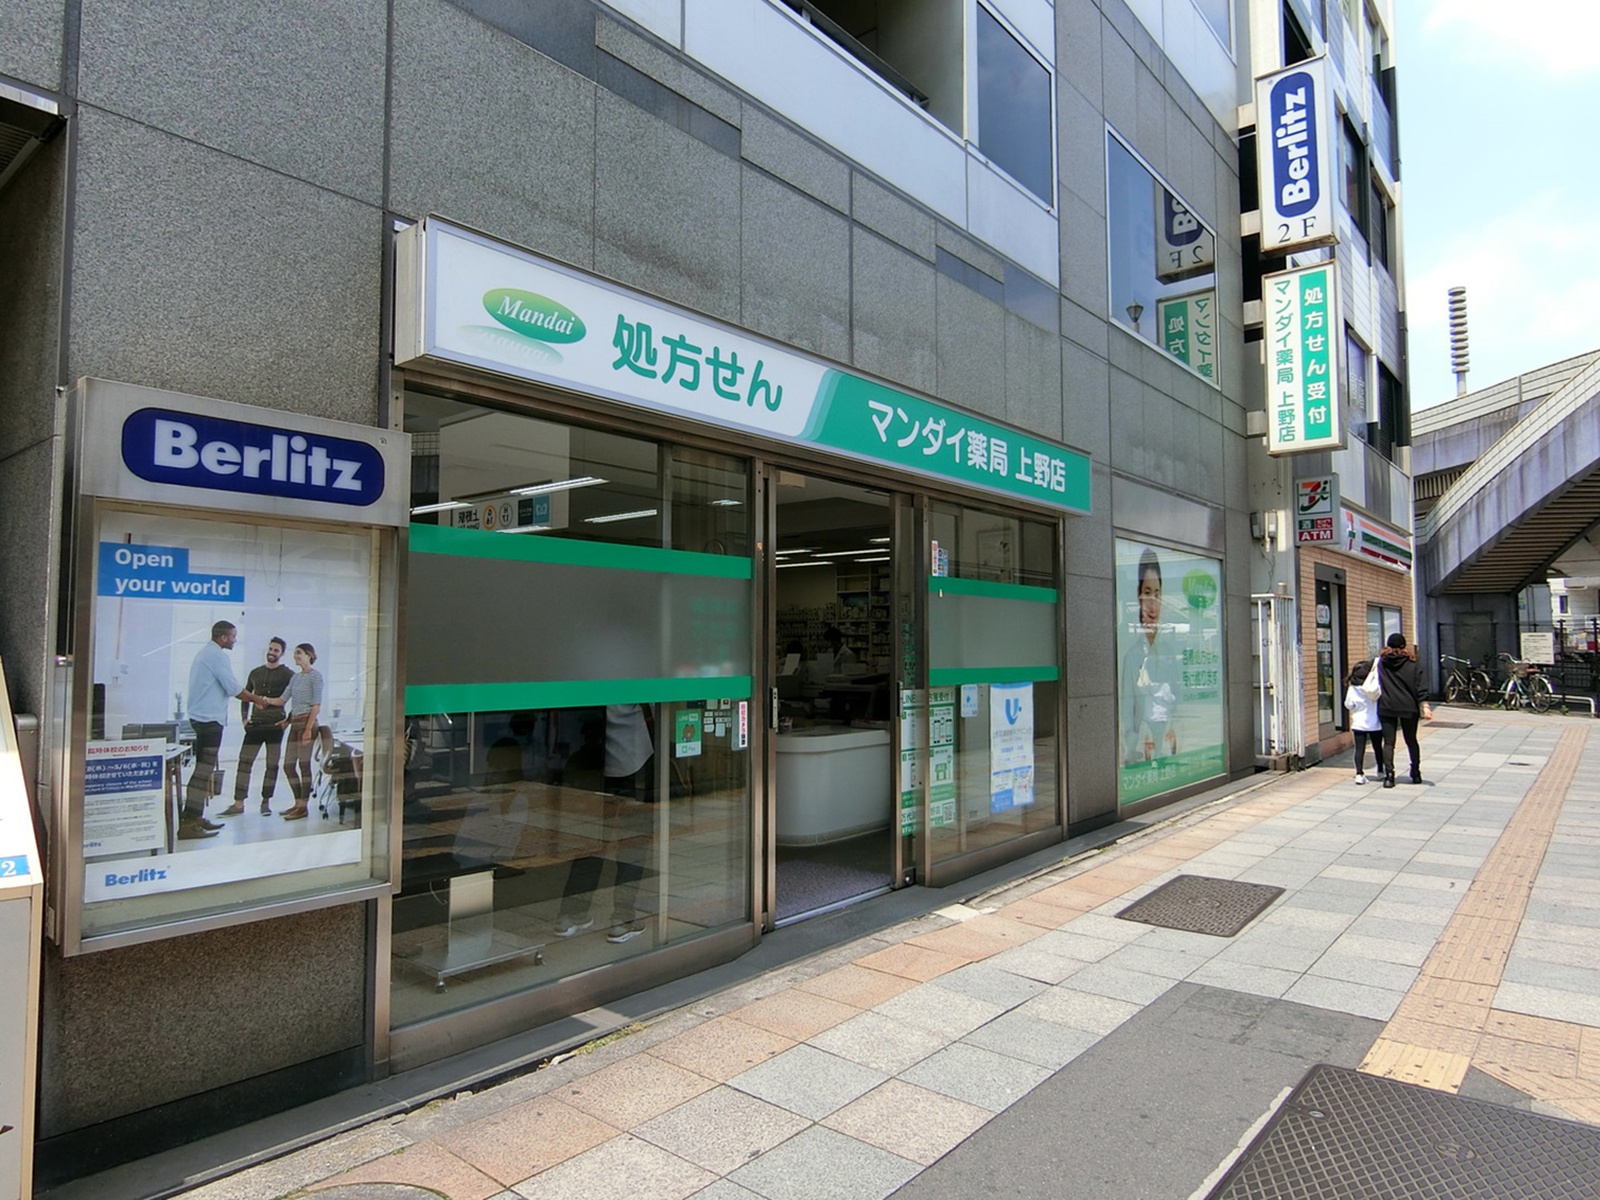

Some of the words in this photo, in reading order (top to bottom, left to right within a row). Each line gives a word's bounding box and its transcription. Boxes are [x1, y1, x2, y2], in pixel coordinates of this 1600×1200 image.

[1275, 87, 1311, 207] Berlitz
[497, 294, 577, 336] Mandai
[1274, 279, 1295, 385] マンダイ薬局
[611, 313, 783, 412] 処方せん
[1304, 286, 1327, 425] 処方せん受付
[868, 400, 1008, 477] マンダイ薬局
[1015, 446, 1066, 493] 上野店
[1277, 391, 1296, 444] 上野店
[153, 418, 363, 492] Berlitz
[115, 548, 174, 568] Open
[1301, 530, 1331, 540] ATM
[115, 577, 166, 594] your
[171, 579, 231, 597] world
[105, 868, 167, 887] Berlitz
